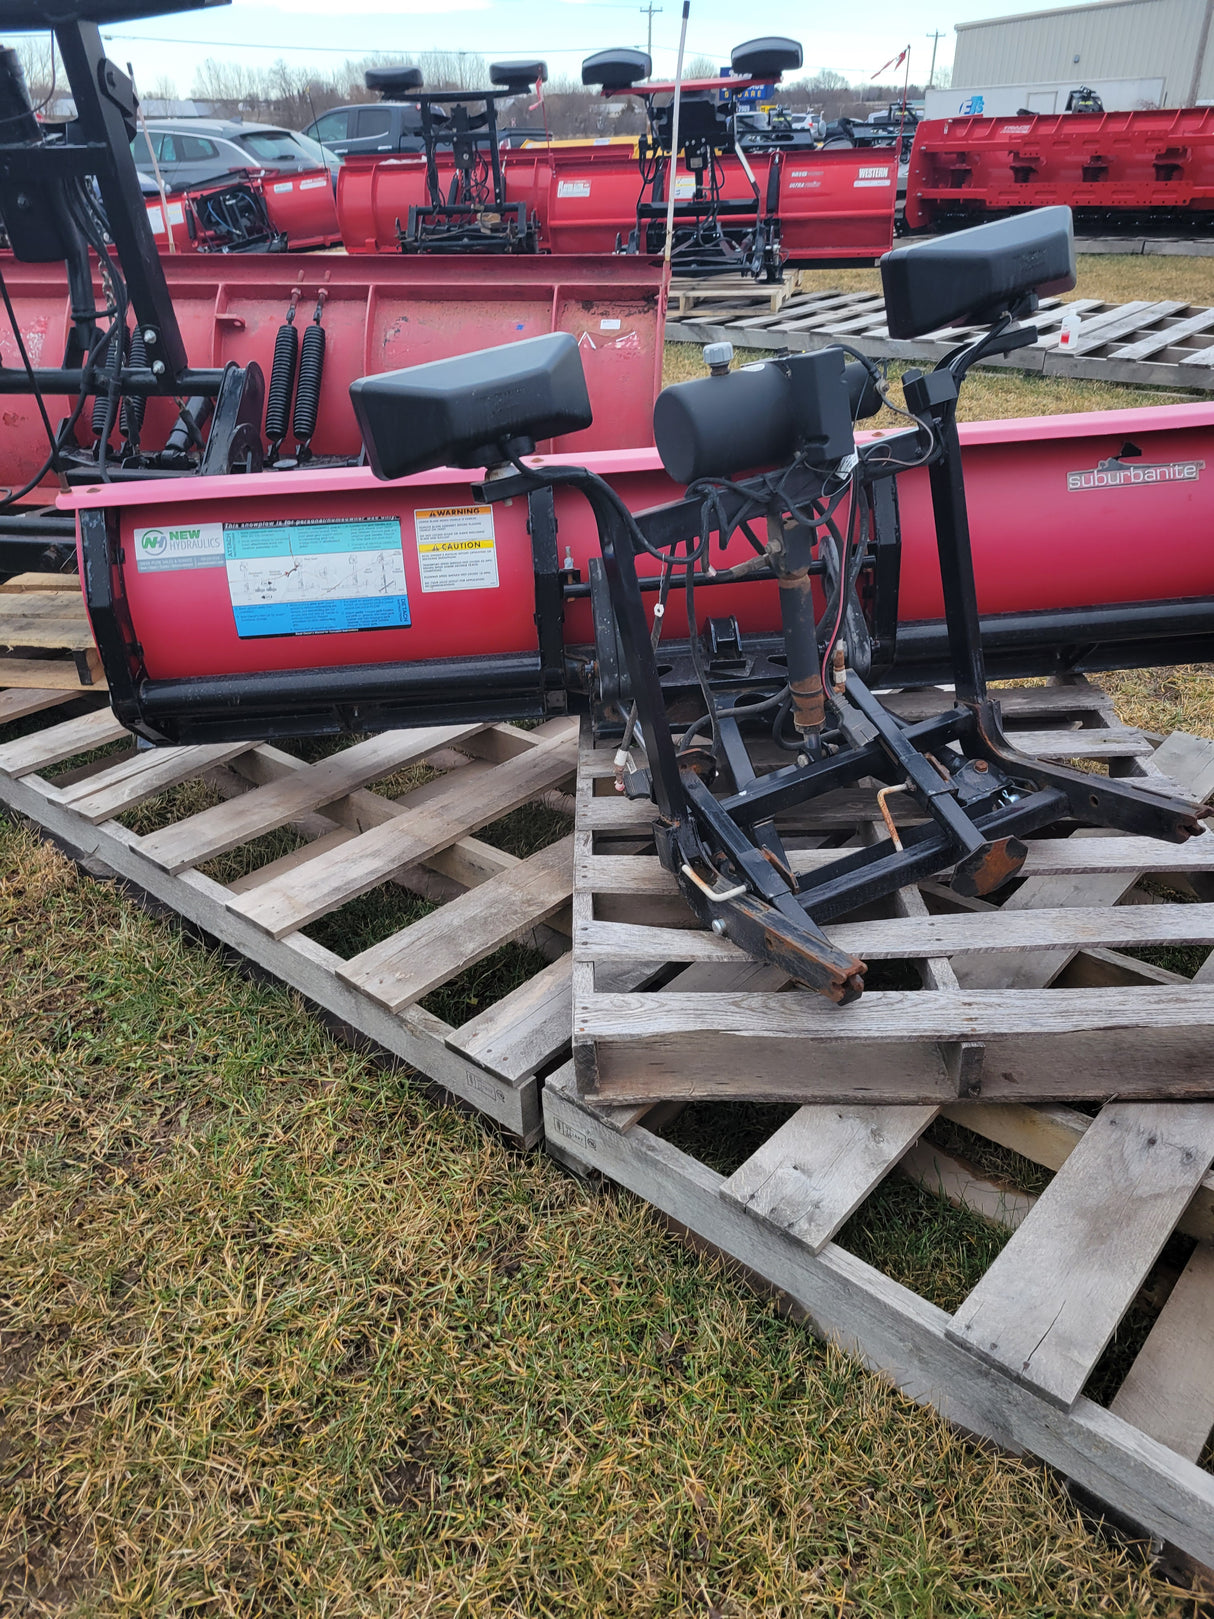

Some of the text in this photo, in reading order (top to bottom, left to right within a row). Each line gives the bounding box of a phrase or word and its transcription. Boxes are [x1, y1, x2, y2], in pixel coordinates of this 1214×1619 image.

[859, 167, 889, 178] WESTERN
[1068, 464, 1197, 489] suburbanite
[438, 508, 480, 517] WARNING
[240, 520, 274, 530] snowplow
[169, 529, 200, 540] NEW
[169, 537, 221, 552] HYDRAULICS
[442, 541, 481, 551] CAUTION
[400, 598, 408, 622] DETACH
